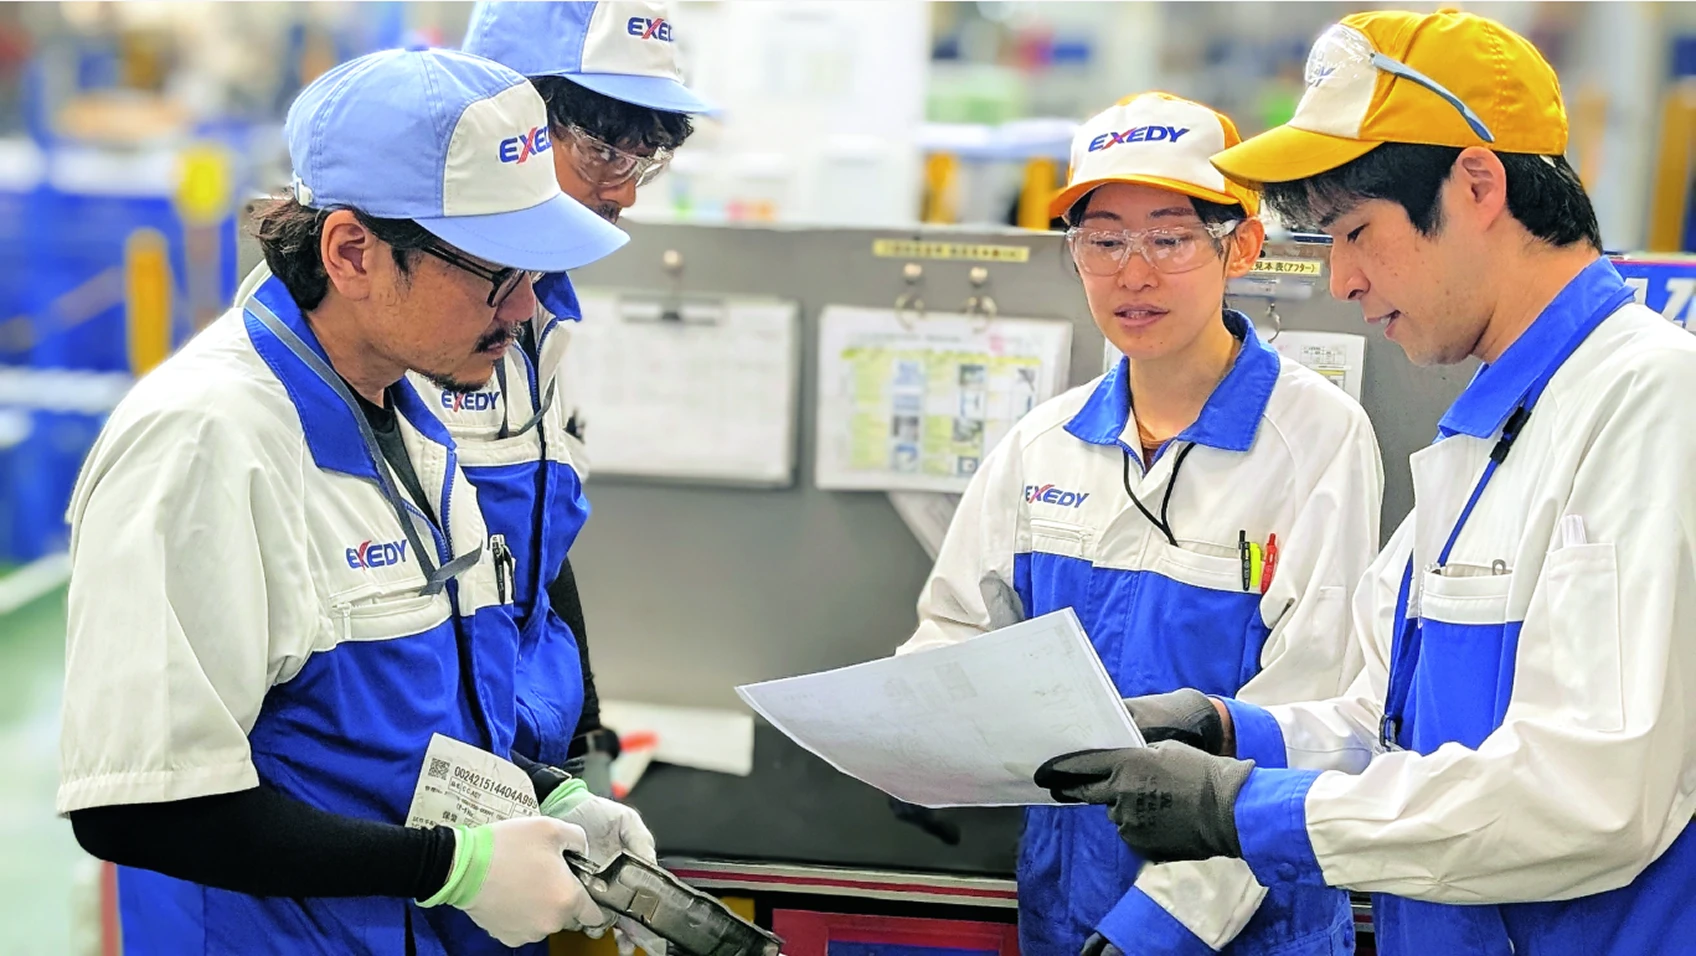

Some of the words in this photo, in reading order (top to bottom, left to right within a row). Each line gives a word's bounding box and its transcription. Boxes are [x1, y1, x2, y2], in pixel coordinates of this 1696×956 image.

[1088, 126, 1190, 152] EXEDY
[1251, 261, 1316, 273] 見本表(アフター)
[441, 390, 500, 412] EXEDY
[1025, 484, 1090, 508] EXEDY
[346, 539, 407, 571] EXEDY
